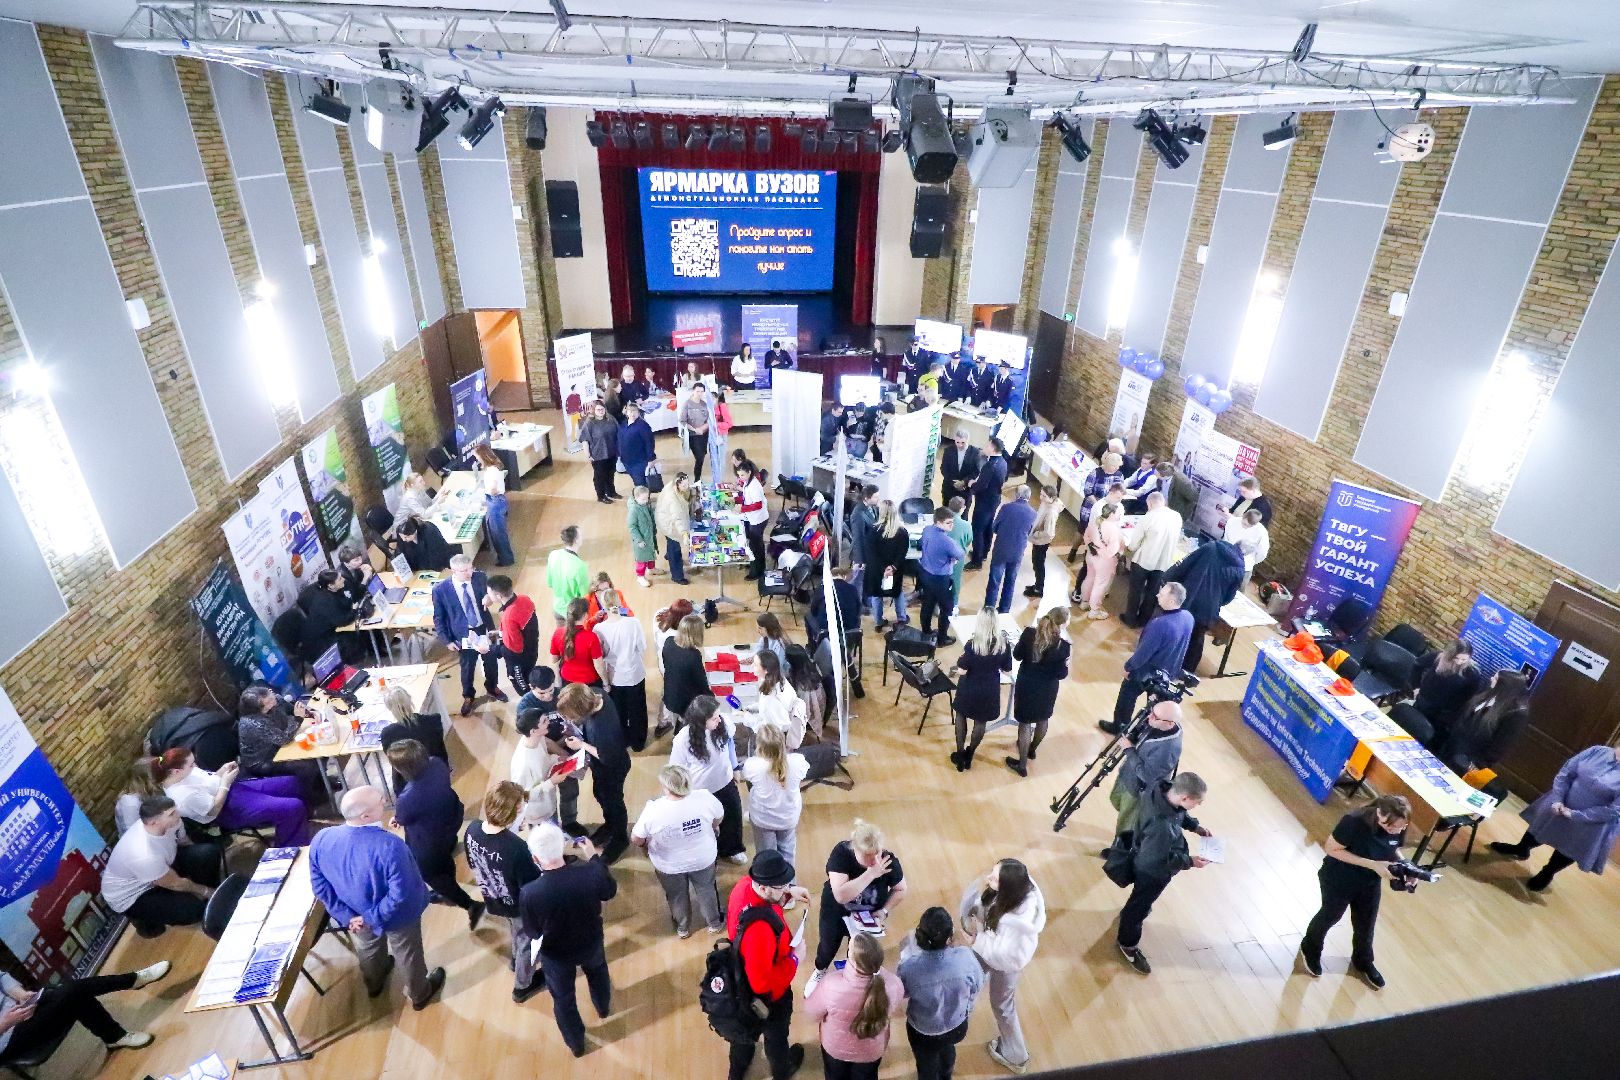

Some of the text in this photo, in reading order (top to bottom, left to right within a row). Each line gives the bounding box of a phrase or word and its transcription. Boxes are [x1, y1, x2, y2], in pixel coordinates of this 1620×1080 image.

[650, 171, 819, 194] ЯРМАРКА ВУЗОВ
[650, 195, 819, 204] ДЕМОНСТРАЦИОННАЯ ПЛОЩАДКА
[730, 224, 775, 241] Пройдите
[778, 229, 804, 241] опрос
[728, 245, 813, 254] помогите нам стать
[757, 261, 785, 274] лучше
[922, 409, 940, 498] ИРЯЗЕВКА
[1330, 518, 1368, 537] ТВГУ
[1325, 532, 1367, 554] ТВОЙ
[1319, 545, 1380, 573] ГАРАНТ
[1315, 558, 1375, 588] УСПЕХА
[1243, 706, 1272, 739] Economics
[1281, 741, 1310, 780] Management
[1276, 720, 1304, 755] Information
[10, 788, 64, 825] УНИВЕРСИТЕТ
